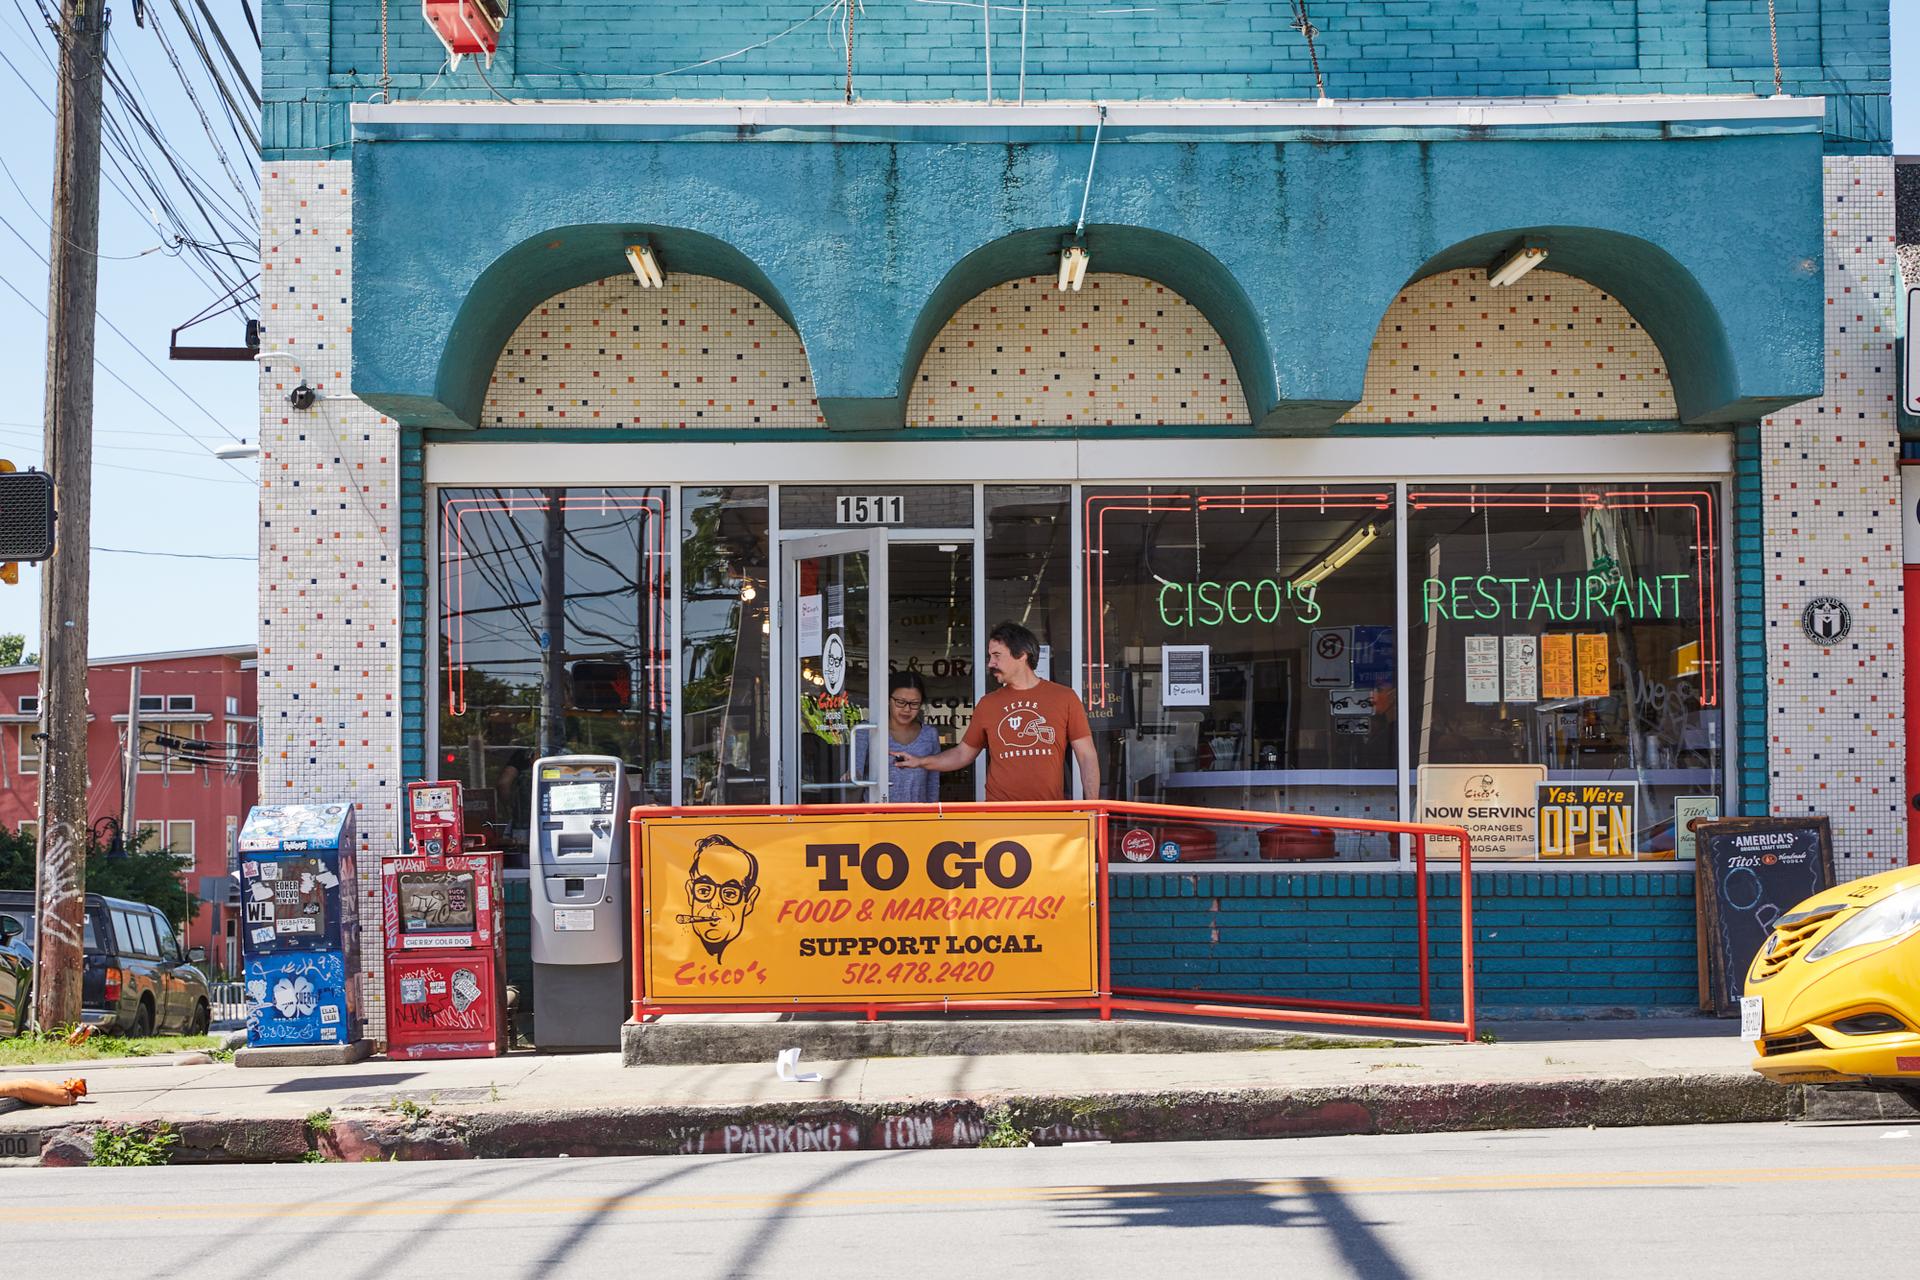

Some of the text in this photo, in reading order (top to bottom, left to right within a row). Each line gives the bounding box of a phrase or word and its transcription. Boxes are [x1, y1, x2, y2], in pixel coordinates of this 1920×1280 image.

[841, 497, 900, 521] 1511
[1159, 579, 1321, 626] CISCO'S
[1423, 574, 1690, 623] RESTAURANT
[1813, 597, 1840, 608] AUSTIN
[1003, 701, 1039, 712] TEXAS
[1000, 748, 1052, 759] LONGHORNS
[1548, 787, 1625, 803] Yes, We're
[1425, 807, 1463, 818] NOW
[1683, 807, 1711, 817] Tito's
[1540, 805, 1632, 856] OPEN
[1735, 833, 1794, 847] AMERICA'S
[805, 840, 1032, 891] TO GO
[1778, 851, 1807, 860] Handmade
[777, 895, 1066, 924] FOOD & MARGARITAS!
[434, 938, 453, 946] COLA
[799, 934, 1043, 957] SUPPORT LOCAL
[674, 961, 767, 986] Cisco's
[841, 960, 995, 985] 512.478.2420
[724, 1121, 842, 1154] PARKING
[884, 1117, 933, 1148] TOW
